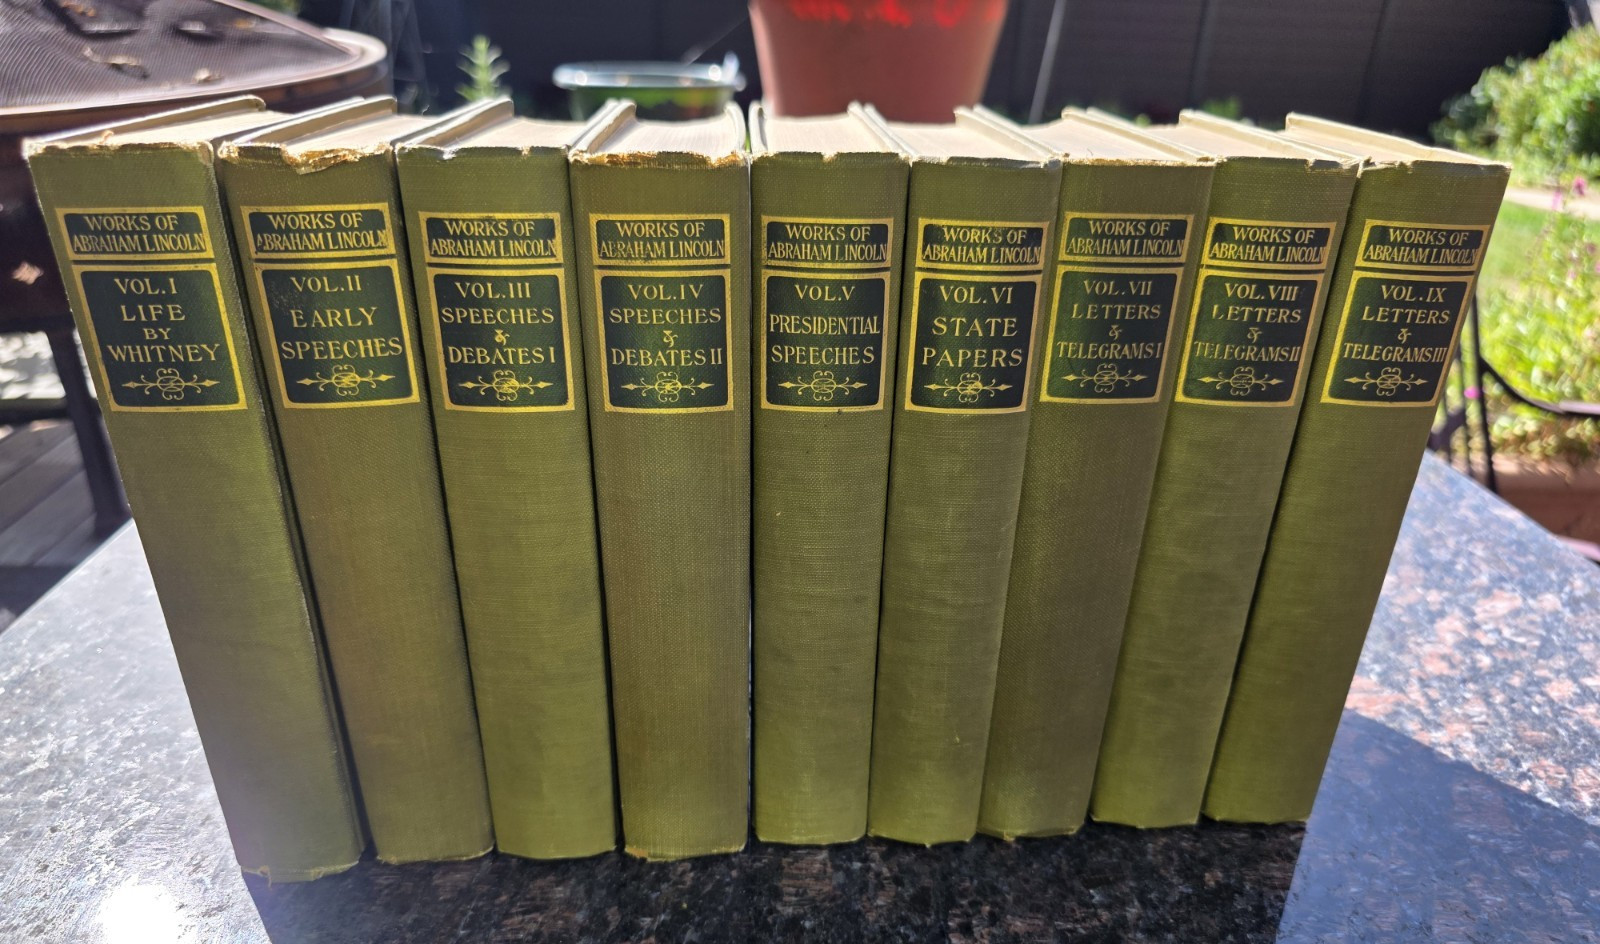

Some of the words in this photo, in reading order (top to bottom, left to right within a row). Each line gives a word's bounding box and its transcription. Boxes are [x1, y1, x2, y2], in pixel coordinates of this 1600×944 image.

[84, 216, 151, 231] WORKS
[155, 215, 178, 230] OF
[269, 214, 335, 230] WORKS
[340, 212, 362, 228] OF
[444, 220, 508, 236] WORKS
[513, 221, 535, 236] OF
[615, 222, 679, 238] WORKS
[684, 222, 705, 237] OF
[1088, 220, 1146, 236] WORKS
[1150, 222, 1170, 236] OF
[72, 234, 140, 251] ABRAHAM
[142, 233, 206, 251] LINCOLN
[256, 232, 324, 251] ABRAHAM
[327, 229, 387, 249] LINCOLN
[785, 225, 846, 241] WORKS
[850, 226, 870, 242] OF
[942, 227, 1002, 244] WORKS
[1007, 229, 1027, 244] OF
[1233, 226, 1290, 242] WORKS
[1295, 230, 1315, 244] OF
[1389, 228, 1446, 246] WORKS
[1450, 232, 1469, 246] OF
[431, 239, 496, 257] ABRAHAM
[499, 239, 558, 257] LINCOLN
[600, 240, 667, 258] ABRAHAM
[670, 240, 724, 258] LINCOLN
[768, 242, 831, 260] ABRAHAM
[835, 244, 887, 261] LINCOLN
[923, 244, 987, 263] ABRAHAM
[990, 246, 1041, 264] LINCOLN
[1067, 238, 1130, 255] ABRAHAM
[1133, 238, 1184, 256] LINCOLN
[1208, 244, 1274, 262] ABRAHAM
[1276, 246, 1326, 263] LINCOLN
[1363, 245, 1429, 263] ABRAHAM
[1430, 248, 1477, 264] LINCOLN
[121, 304, 186, 321] LIFE
[291, 307, 378, 328] EARLY
[441, 308, 554, 325] SPEECHES
[609, 308, 722, 325] SPEECHES
[1072, 303, 1161, 320] LETTERS
[1212, 304, 1302, 323] LETTERS
[1362, 306, 1450, 324] LETTERS
[143, 328, 171, 340] BY
[769, 315, 880, 335] PRESIDENTIAL
[932, 317, 1018, 337] STATE
[107, 343, 220, 362] WHITNEY
[281, 338, 403, 360] SPEECHES
[449, 346, 546, 365] DEBATES
[611, 348, 706, 366] DEBATES
[771, 346, 875, 365] SPEECHES
[922, 348, 1023, 368] PAPERS
